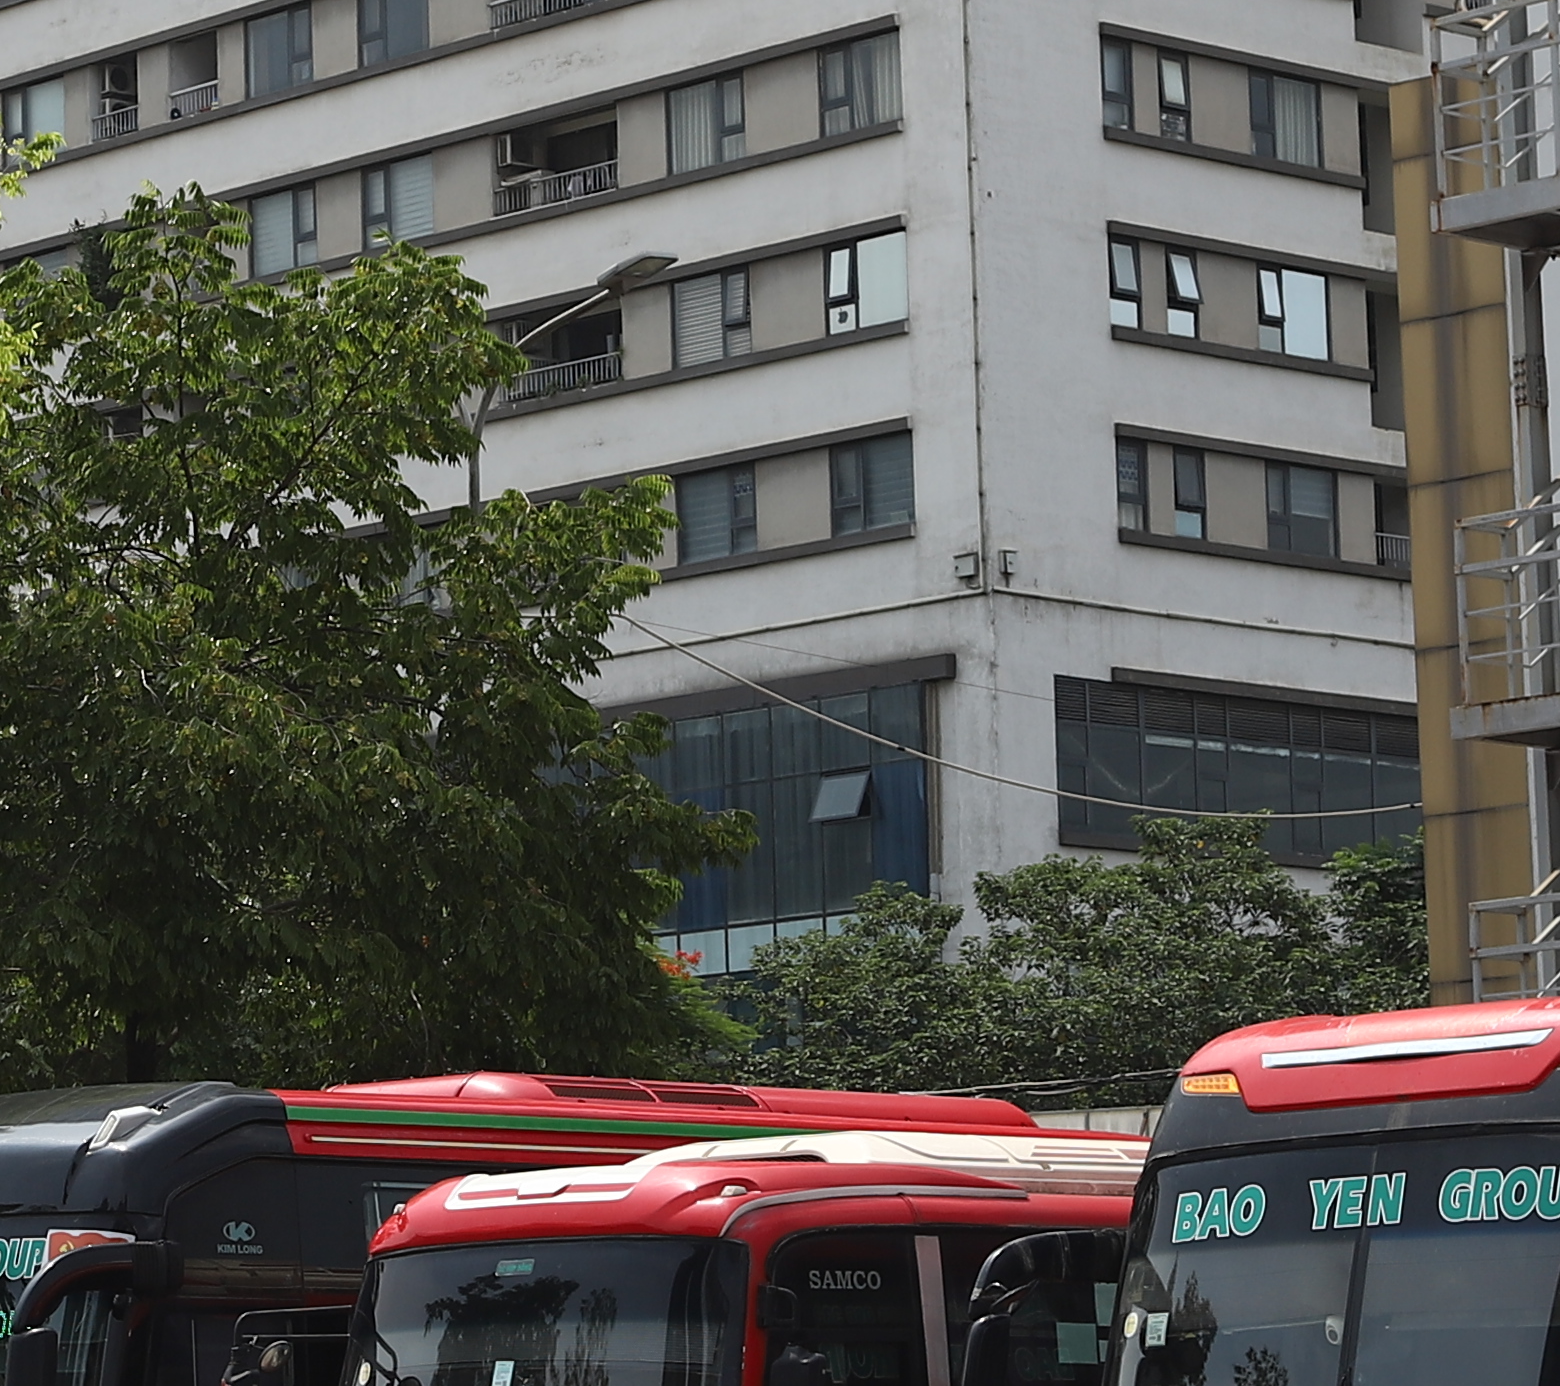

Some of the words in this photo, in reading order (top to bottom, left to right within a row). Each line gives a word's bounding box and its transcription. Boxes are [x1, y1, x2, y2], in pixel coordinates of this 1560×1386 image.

[1172, 1184, 1266, 1243] BAO
[1309, 1172, 1406, 1231] YEN
[217, 1244, 236, 1254] KIM
[237, 1244, 263, 1255] LONG
[808, 1270, 881, 1290] SAMCO
